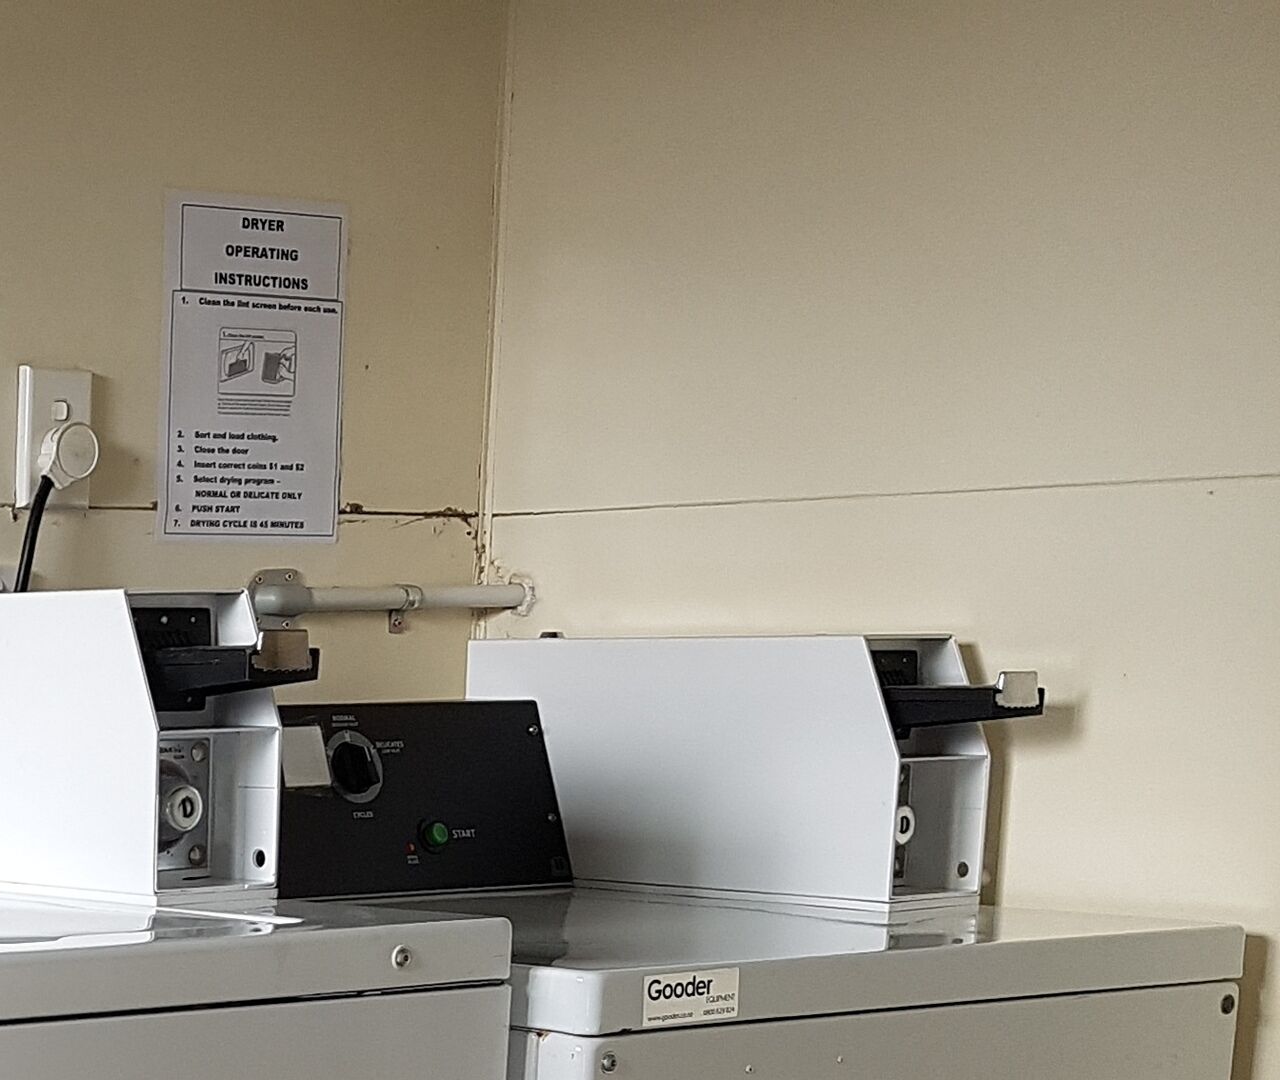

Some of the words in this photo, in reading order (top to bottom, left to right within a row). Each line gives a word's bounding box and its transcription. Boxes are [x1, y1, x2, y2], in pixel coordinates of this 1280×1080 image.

[242, 217, 284, 232] DRYER
[226, 244, 298, 261] OPERATING
[214, 272, 308, 290] INSTRUCTIONS
[182, 296, 188, 304] 1.
[199, 298, 221, 307] Clean
[223, 299, 235, 308] the
[237, 300, 250, 308] lint
[252, 302, 276, 310] screen
[278, 302, 302, 312] before
[304, 305, 321, 313] each
[323, 306, 338, 314] use.
[177, 430, 184, 438] 2.
[194, 431, 210, 439] Sort
[212, 432, 226, 440] and
[228, 432, 244, 440] load
[246, 433, 278, 443] clothing.
[194, 446, 216, 454] Close
[194, 461, 216, 470] Insert
[218, 462, 246, 470] correct
[247, 462, 267, 470] coins
[193, 476, 218, 484] Select
[219, 476, 242, 486] drying
[244, 478, 274, 486] program
[195, 490, 228, 498] NORMAL
[243, 492, 280, 500] DELICATE
[282, 492, 302, 500] ONLY
[192, 505, 213, 513] PUSH
[174, 520, 180, 528] 7.
[190, 520, 220, 528] DRYING
[222, 520, 248, 528] CYCLE
[452, 829, 476, 838] START
[648, 975, 713, 1001] Gooder
